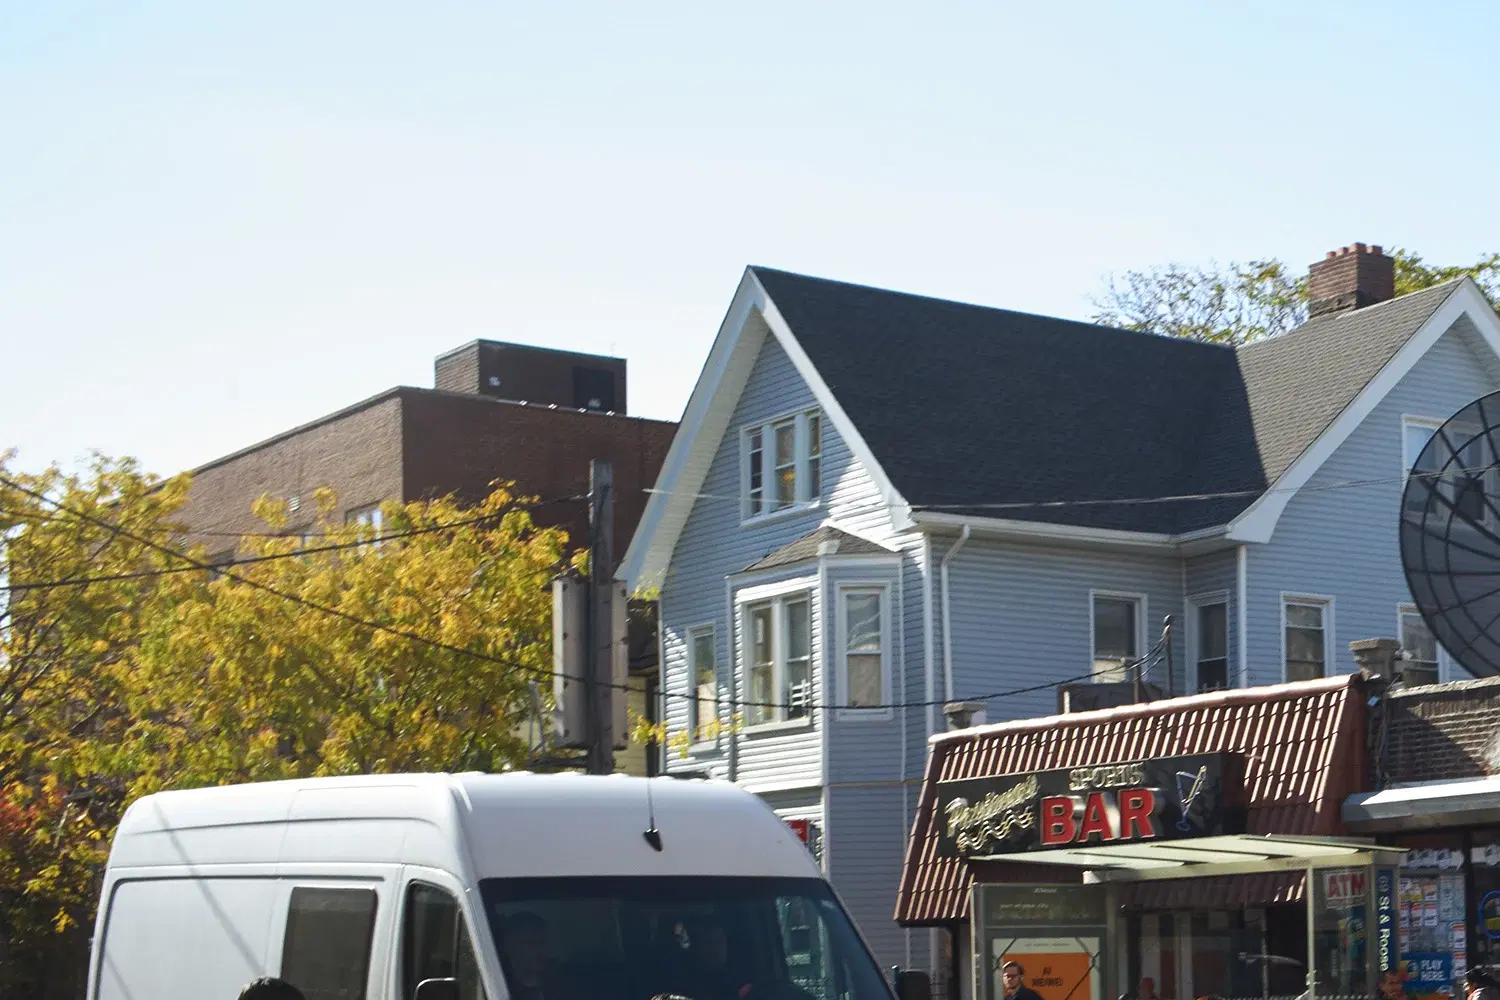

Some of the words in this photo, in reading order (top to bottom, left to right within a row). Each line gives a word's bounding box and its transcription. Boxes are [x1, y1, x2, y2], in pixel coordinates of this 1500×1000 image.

[1069, 762, 1145, 791] SPORTS
[1041, 787, 1156, 846] BAR
[1327, 872, 1367, 898] ATM
[1378, 896, 1391, 911] St
[1378, 914, 1391, 925] &
[1420, 959, 1443, 971] PLAY
